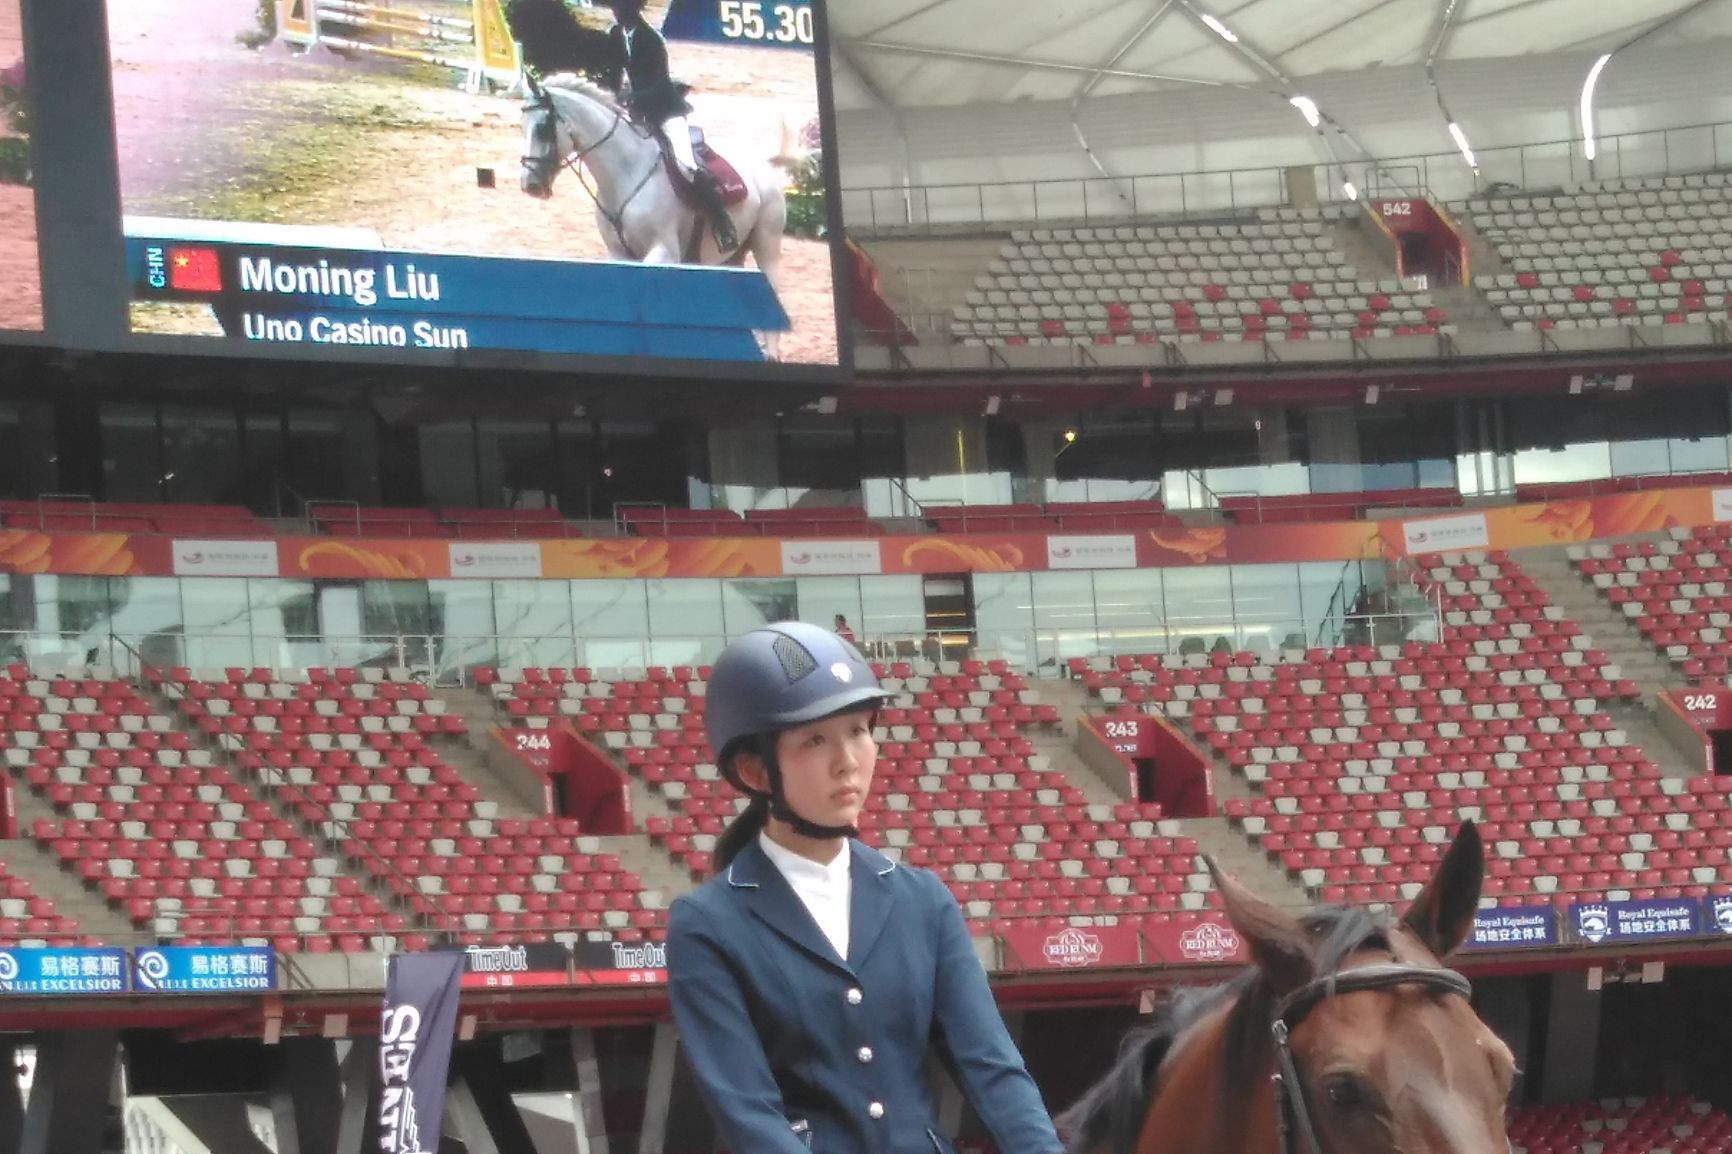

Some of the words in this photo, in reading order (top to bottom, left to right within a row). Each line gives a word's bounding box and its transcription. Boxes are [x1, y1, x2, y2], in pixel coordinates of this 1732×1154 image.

[721, 1, 814, 43] 55.30
[1383, 203, 1411, 216] 542
[147, 247, 165, 288] CHN
[239, 257, 377, 305] Moning
[386, 264, 440, 300] Liu
[244, 314, 302, 341] Uno
[310, 317, 406, 347] Casino
[414, 322, 468, 349] Sun
[1684, 695, 1717, 711] 242
[1105, 721, 1138, 738] 243
[517, 735, 551, 750] 244
[41, 956, 120, 976] 易格赛斯
[192, 955, 267, 975] 易格赛斯
[41, 979, 122, 991] EXCELSIOR
[192, 977, 269, 989] EXCELSIOR
